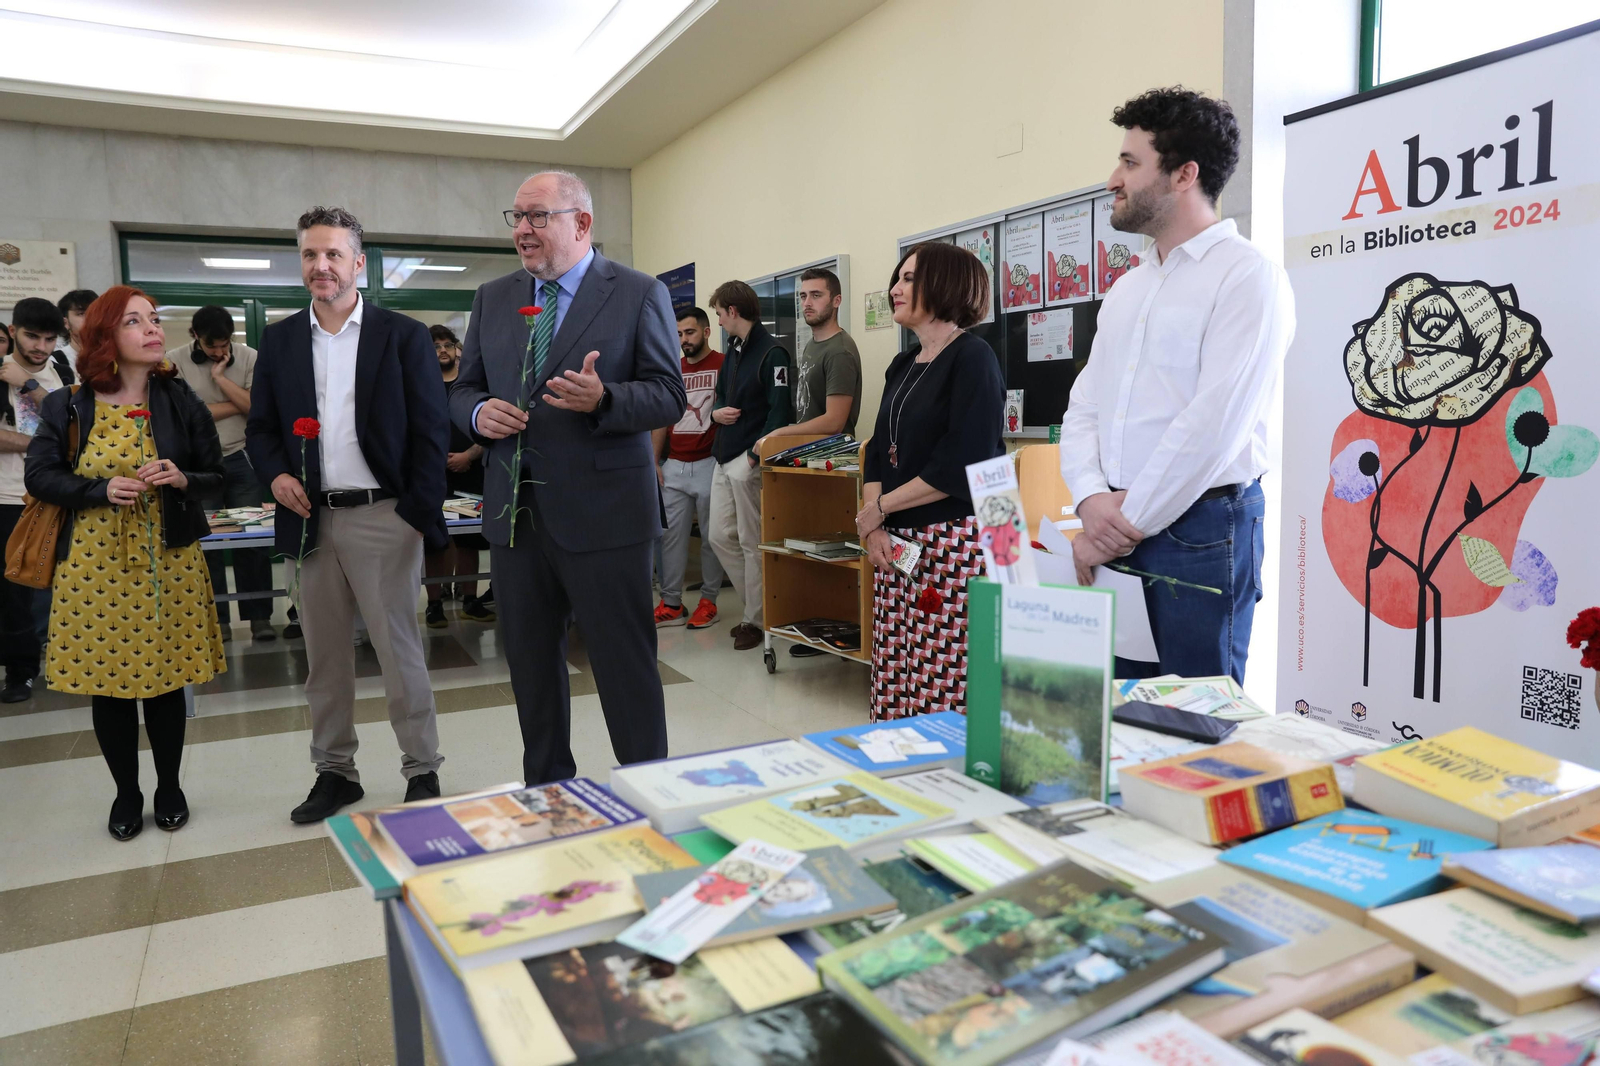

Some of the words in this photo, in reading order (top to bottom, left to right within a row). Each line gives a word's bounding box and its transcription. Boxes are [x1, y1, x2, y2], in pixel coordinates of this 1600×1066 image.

[1342, 99, 1558, 221] Abril
[1310, 242, 1333, 259] en
[1340, 234, 1356, 254] la
[1364, 219, 1477, 251] Biblioteca
[1493, 199, 1561, 231] 2024
[684, 374, 712, 390] UMA
[776, 368, 787, 384] 4
[1297, 514, 1306, 672] www.uco.es/servicios/biblioteca/
[1008, 598, 1050, 613] Laguna
[1052, 610, 1100, 628] Madres
